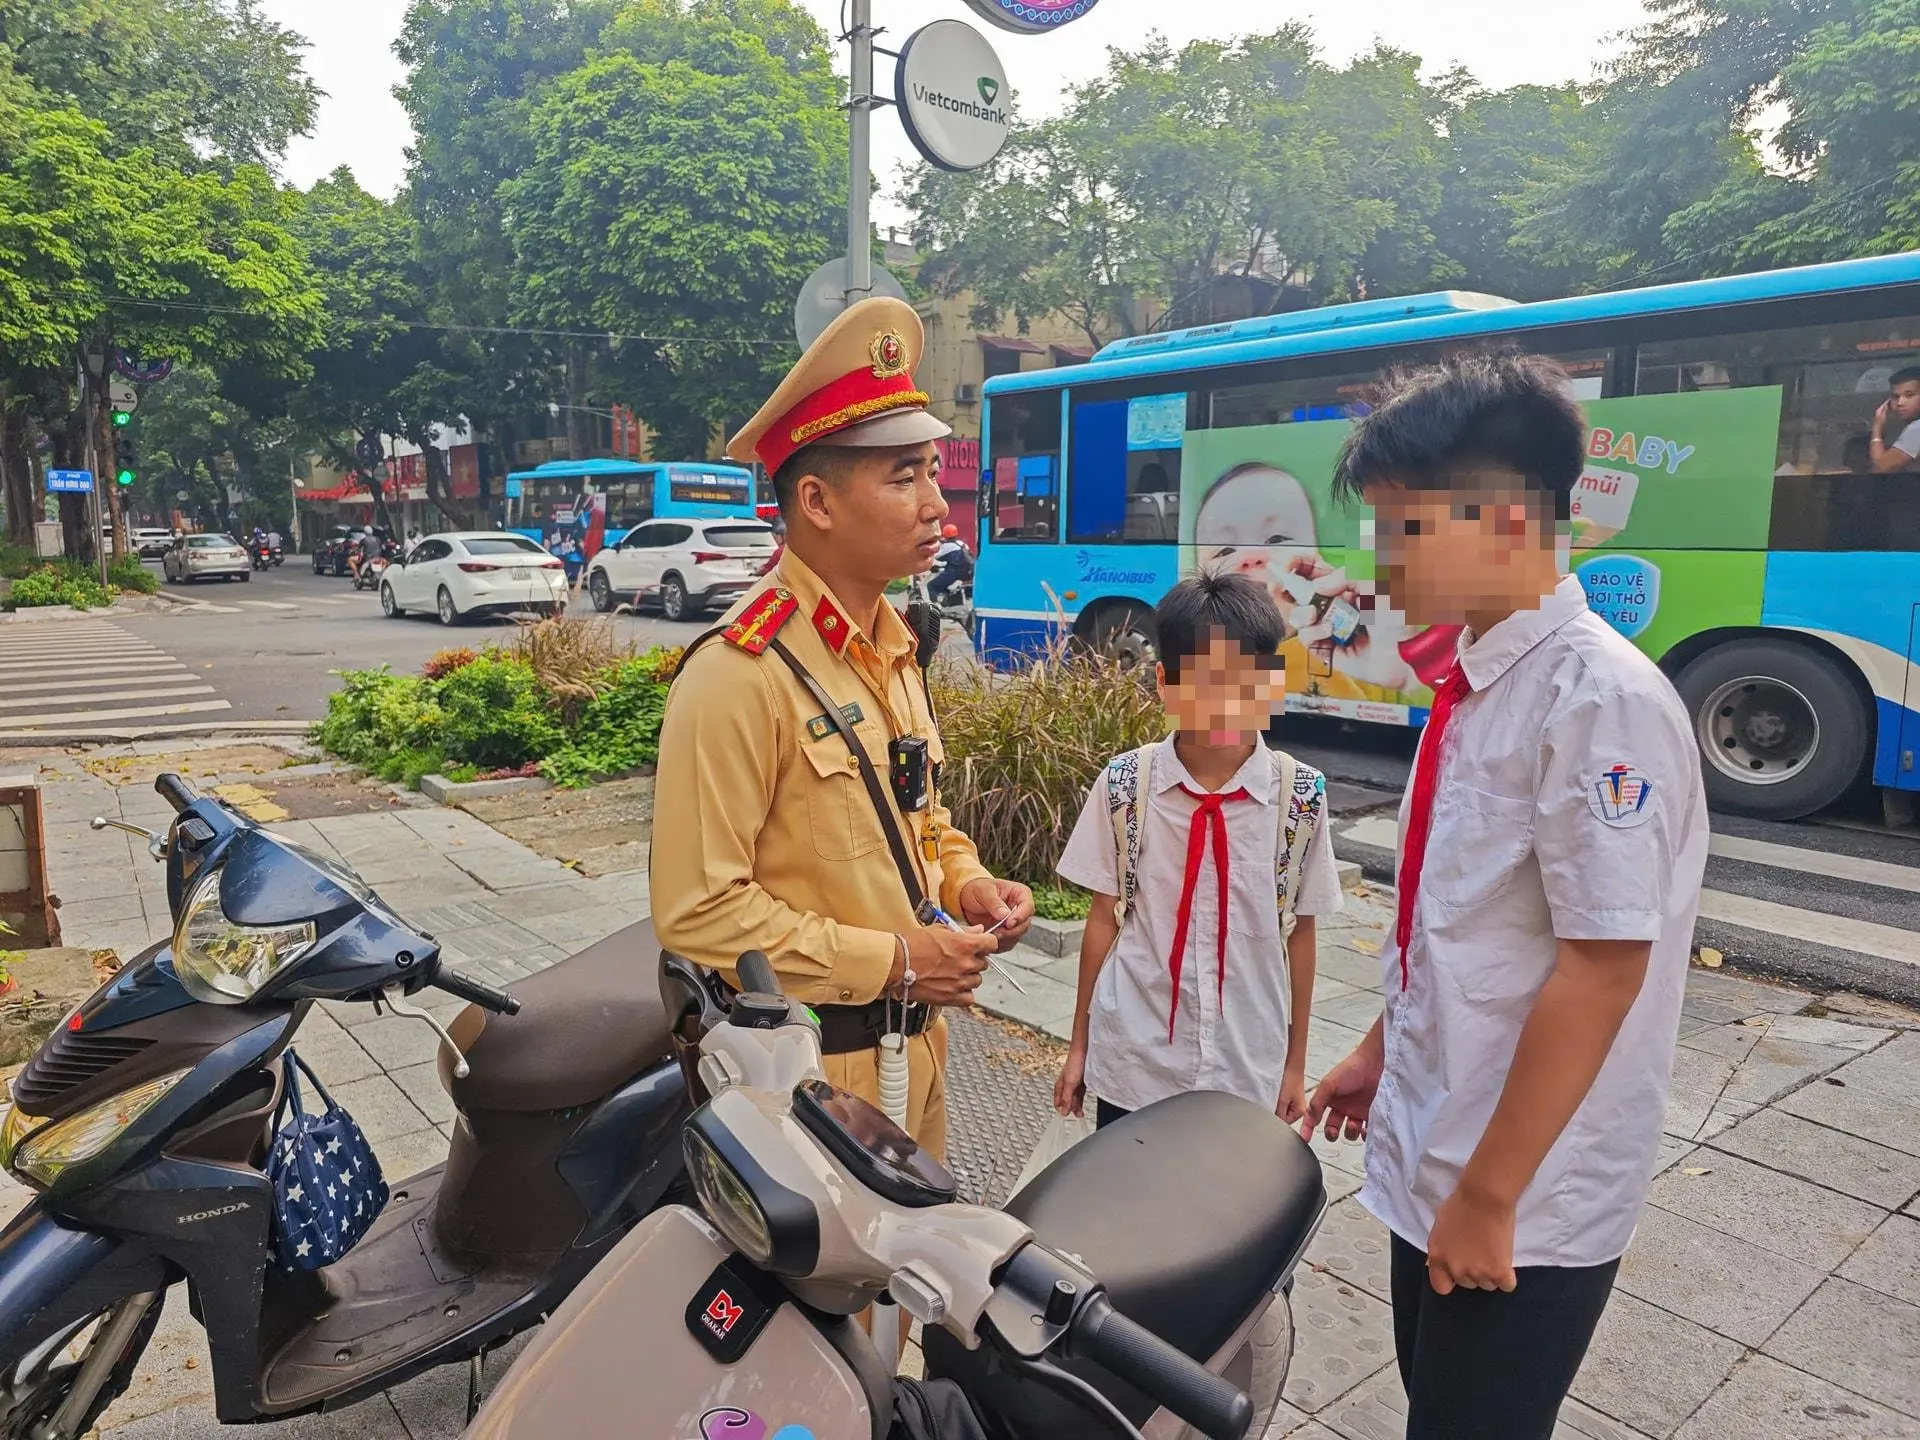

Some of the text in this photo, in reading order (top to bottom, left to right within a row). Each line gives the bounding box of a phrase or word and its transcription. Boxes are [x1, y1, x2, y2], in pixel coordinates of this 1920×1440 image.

[913, 82, 1006, 125] Vietcombank
[1587, 427, 1696, 474] BABY
[1580, 475, 1623, 496] mũi
[1590, 570, 1644, 590] BẢO VỆ
[1616, 589, 1646, 605] THỞ
[1611, 609, 1638, 624] YÊU
[177, 1202, 252, 1224] HONDA
[701, 1313, 726, 1340] OSAKAR
